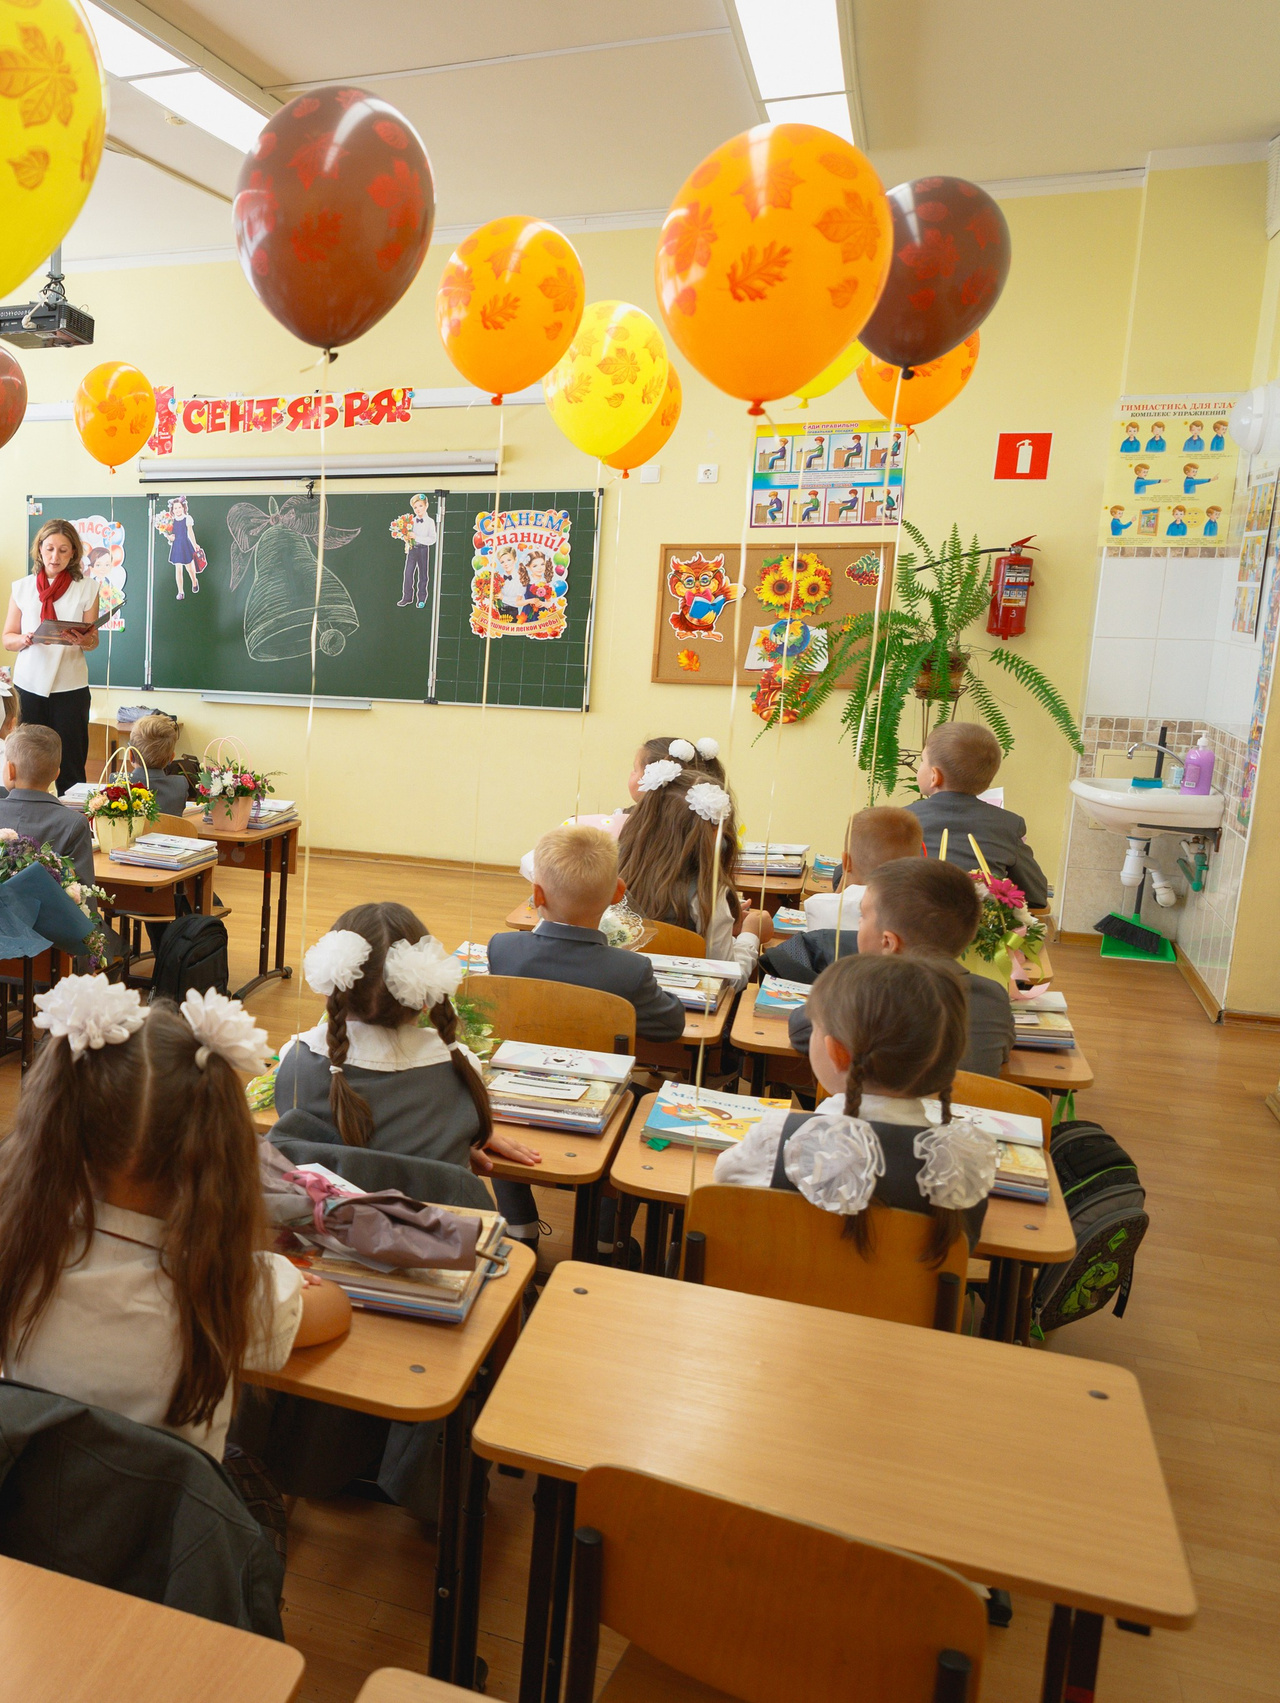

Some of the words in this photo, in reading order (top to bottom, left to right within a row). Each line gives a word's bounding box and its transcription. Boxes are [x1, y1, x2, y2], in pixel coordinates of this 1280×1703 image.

[182, 388, 414, 434] СЕНТЯБРЯ!
[1120, 403, 1187, 411] ГИМНАСТИКА
[1189, 402, 1211, 411] ДЛЯ
[1172, 409, 1227, 417] УПРАЖНЕНИЙ
[73, 522, 116, 541] ЛАСС!
